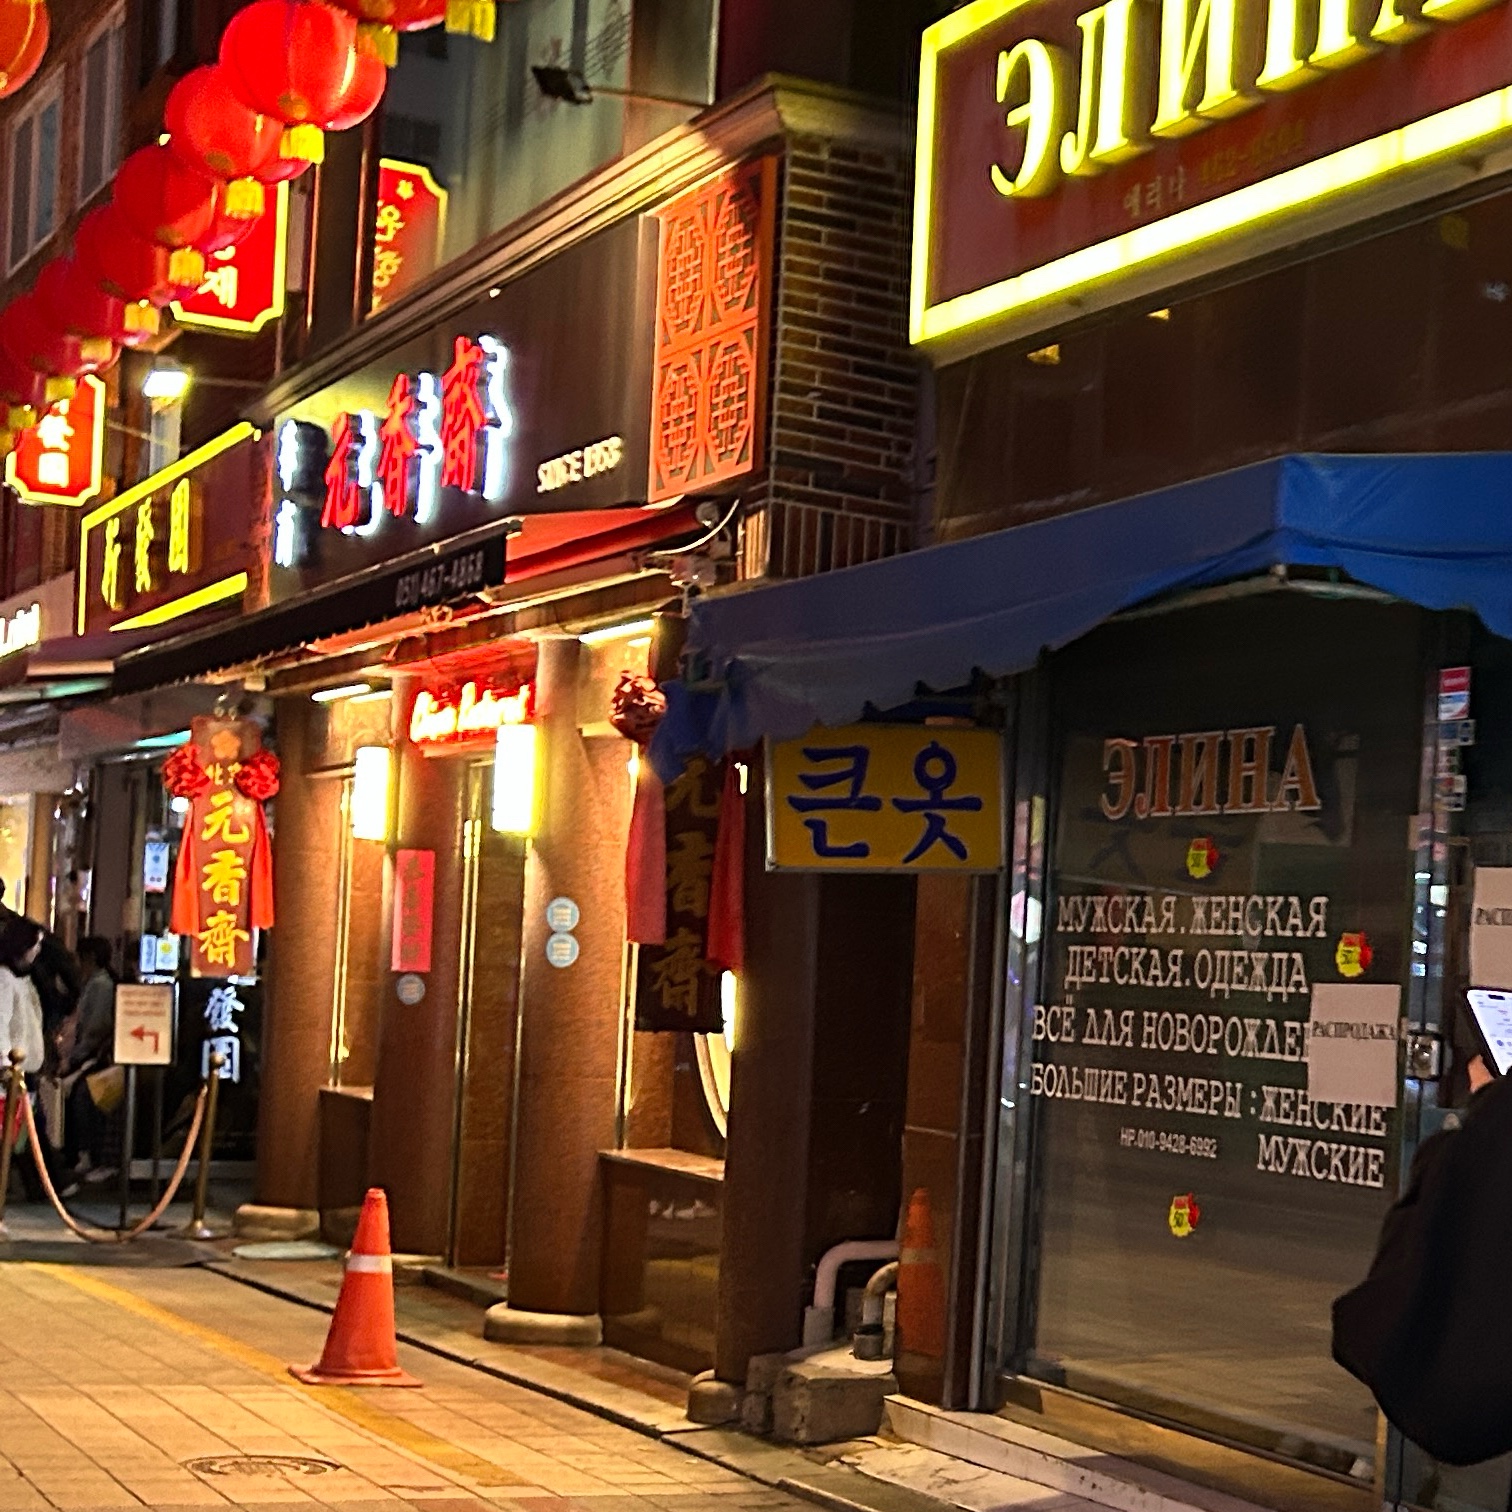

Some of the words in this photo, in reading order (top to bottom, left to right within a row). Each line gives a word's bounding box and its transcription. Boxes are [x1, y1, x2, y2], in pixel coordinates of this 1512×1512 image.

[1101, 723, 1322, 820] ЭЛИНА
[1032, 995, 1075, 1042] ВСЁ
[1082, 1008, 1134, 1048] ДЛЯ
[1030, 1063, 1127, 1105] БОЛЬШИЕ
[1257, 1134, 1385, 1188] МУЖСКИЕ
